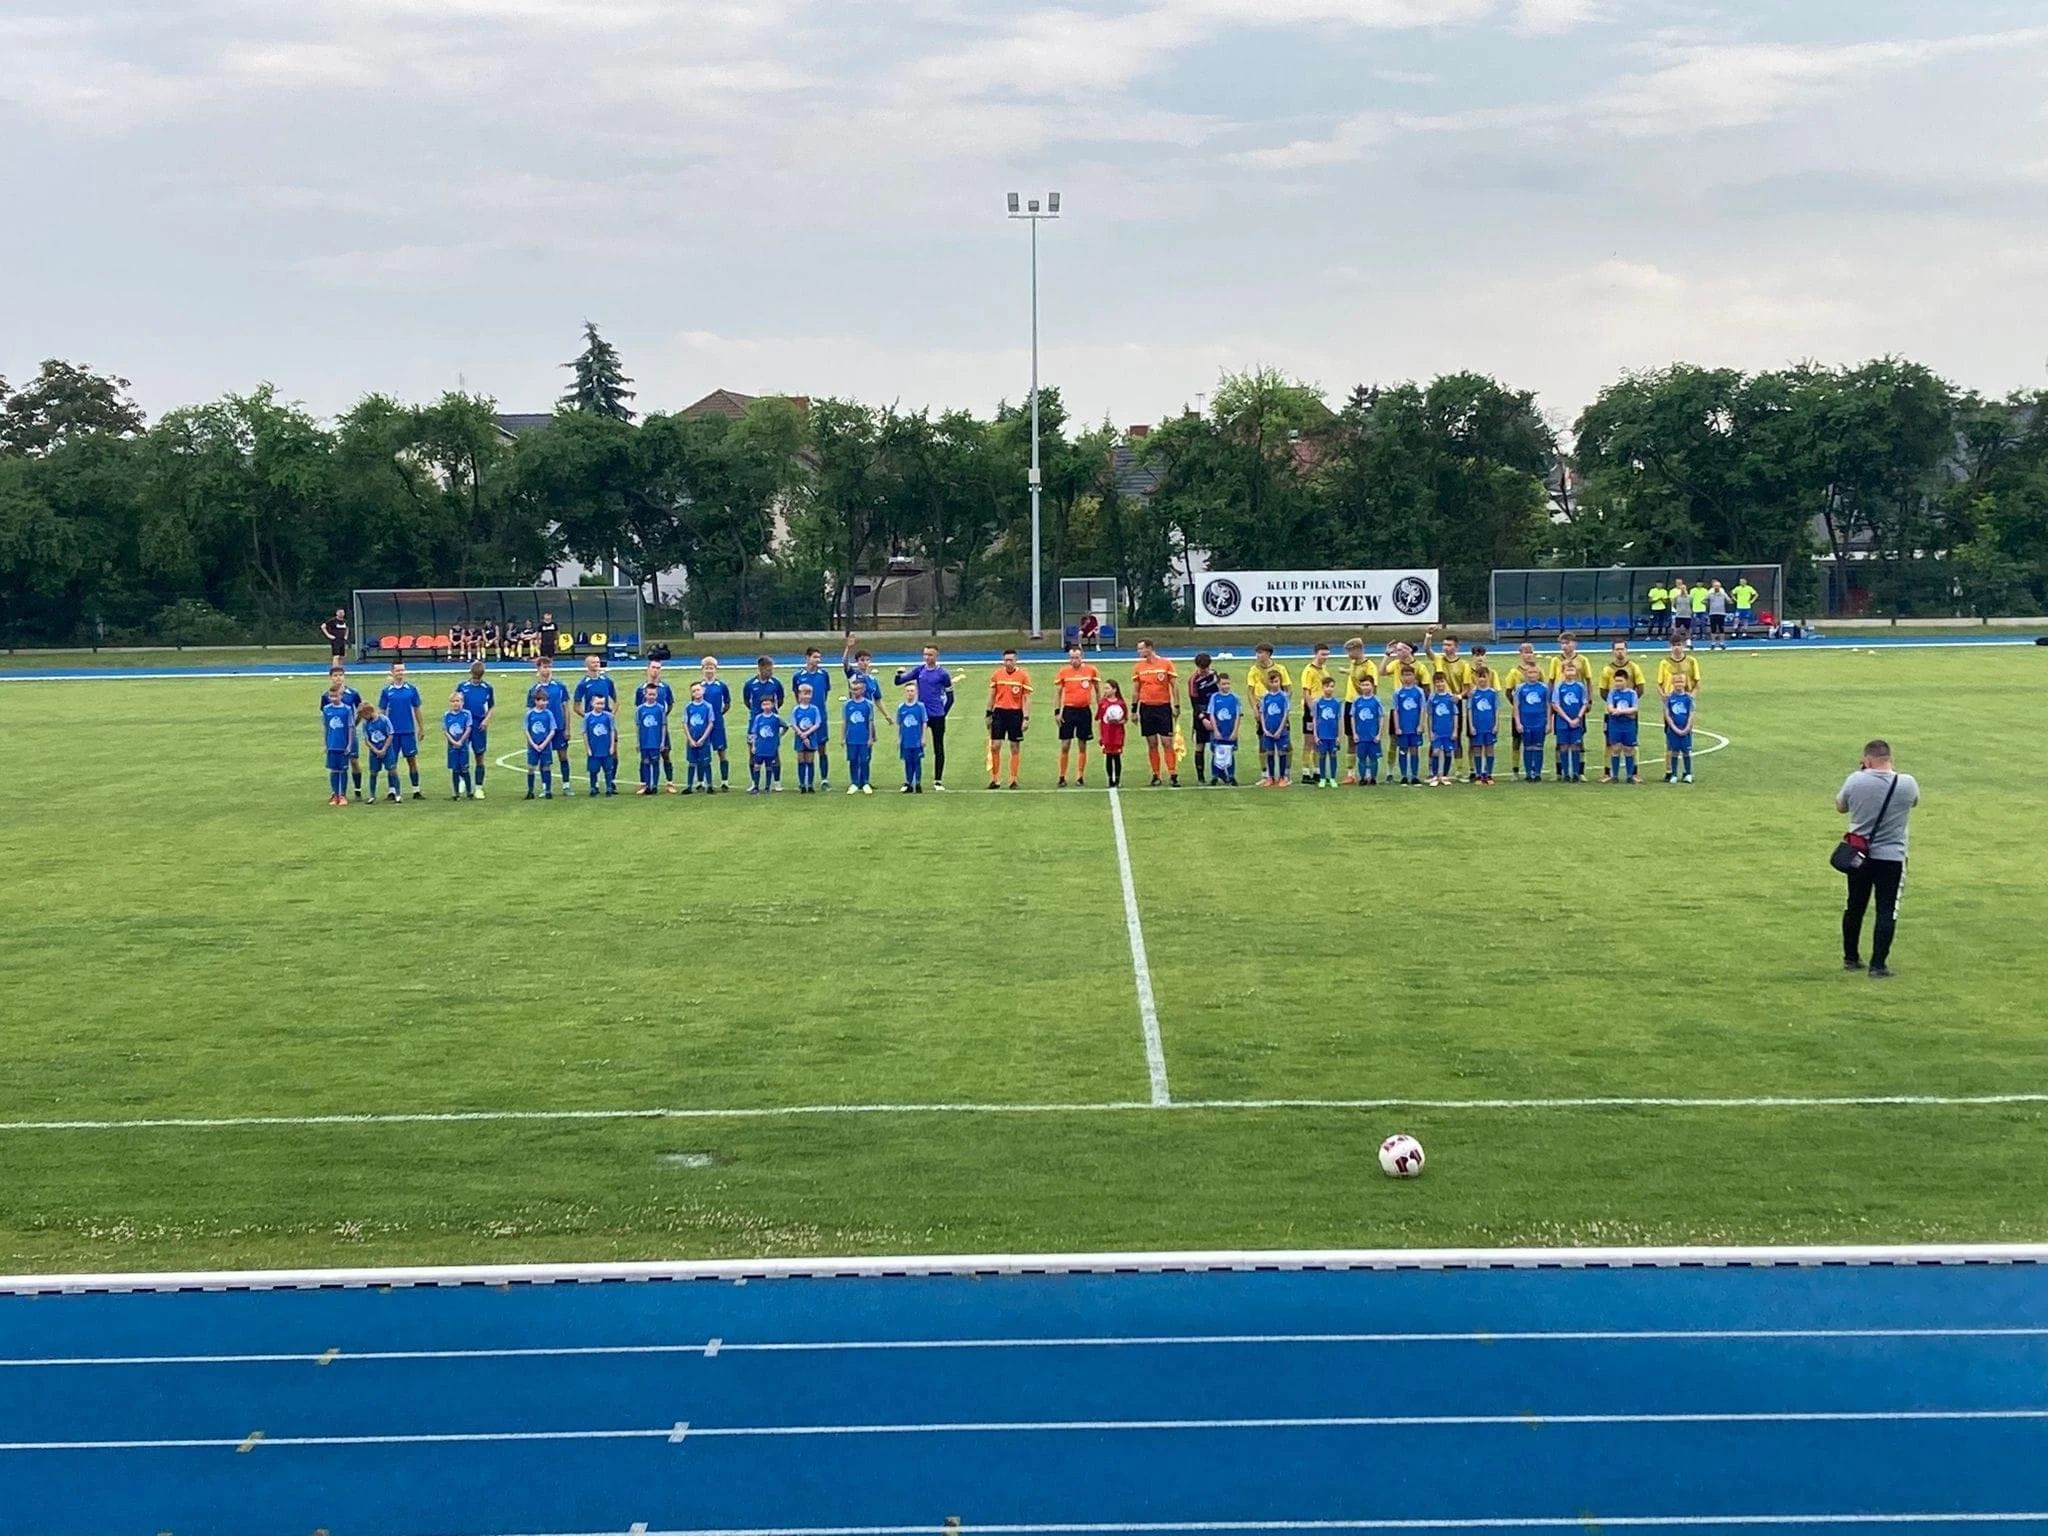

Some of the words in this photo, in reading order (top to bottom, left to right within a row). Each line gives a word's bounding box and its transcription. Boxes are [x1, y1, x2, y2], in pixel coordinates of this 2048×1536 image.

[1267, 581, 1298, 590] KLUB
[1251, 596, 1306, 612] GRYF
[1313, 595, 1382, 612] TCZEW
